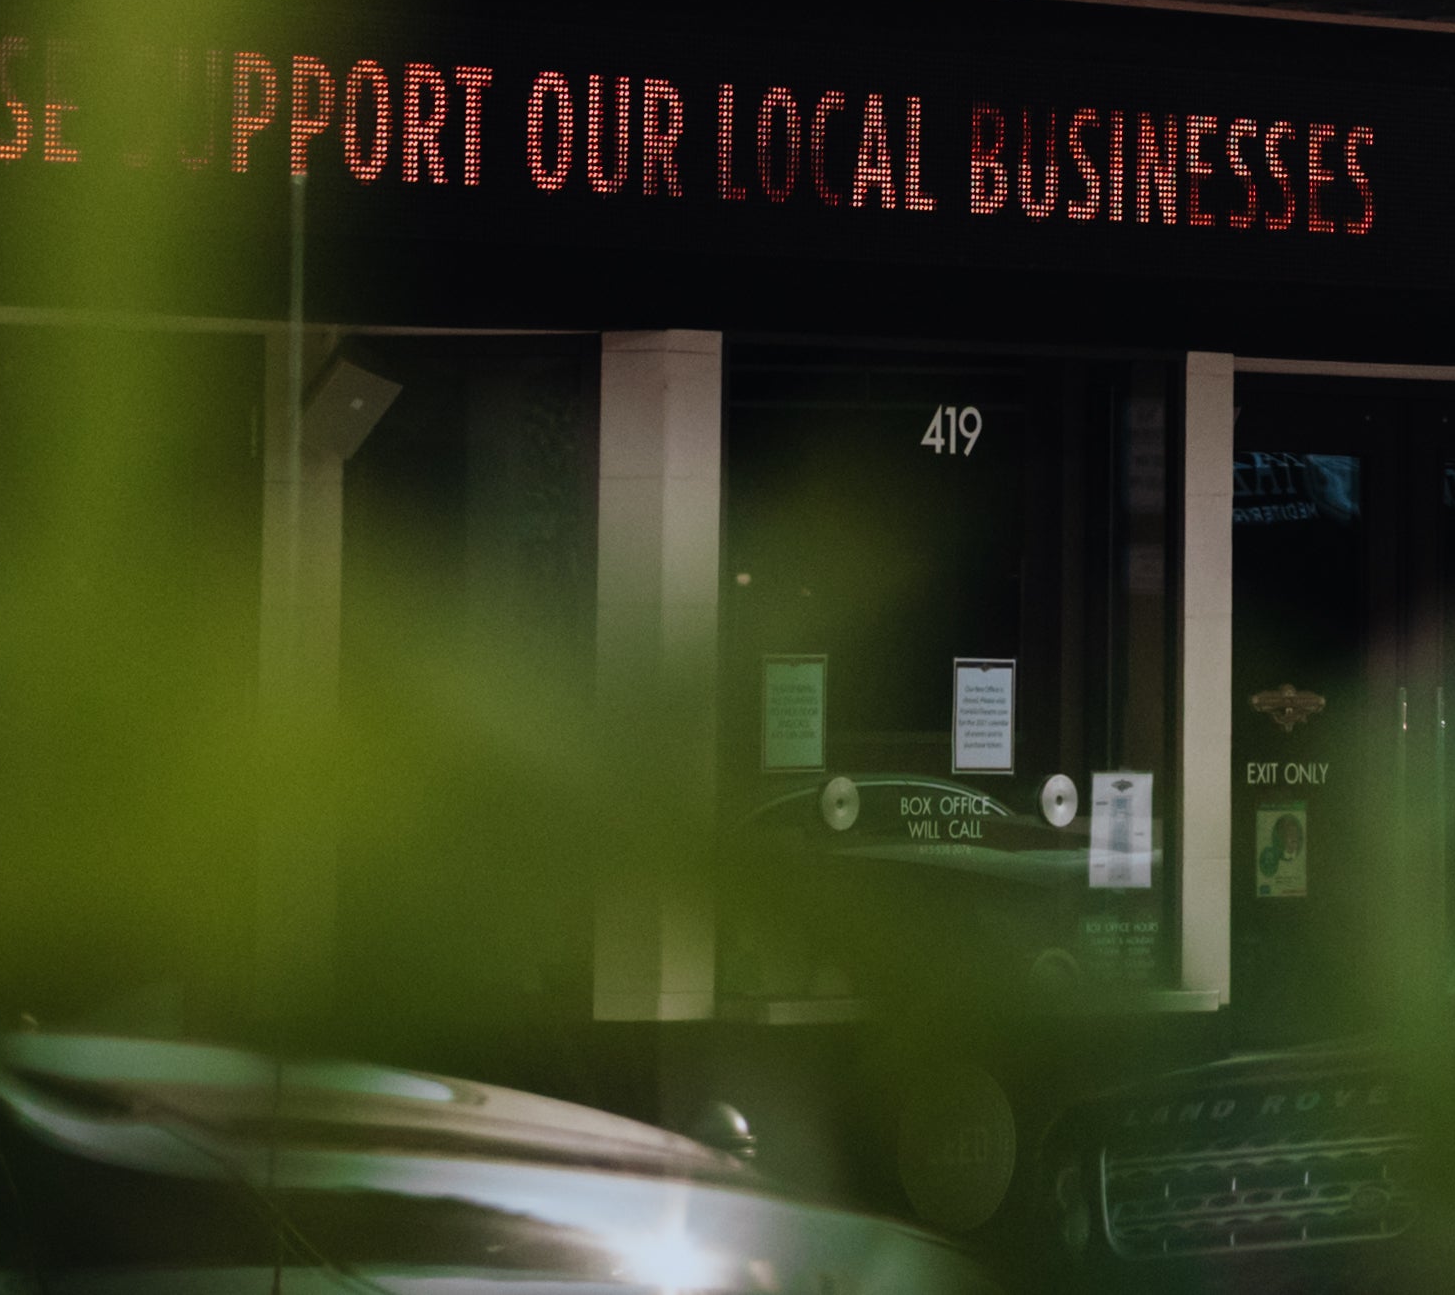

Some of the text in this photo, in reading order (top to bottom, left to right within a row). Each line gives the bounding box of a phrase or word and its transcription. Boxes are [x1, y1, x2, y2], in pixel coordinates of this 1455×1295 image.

[125, 46, 493, 186] UPPORT
[526, 69, 684, 198] OUR
[717, 82, 937, 212] LOCAL
[969, 101, 1375, 235] BUSINESSES
[920, 403, 983, 457] 419
[1247, 762, 1330, 785] EXIT ONLY
[900, 796, 991, 816] BOX OFFICE
[907, 820, 984, 840] WILL CALL
